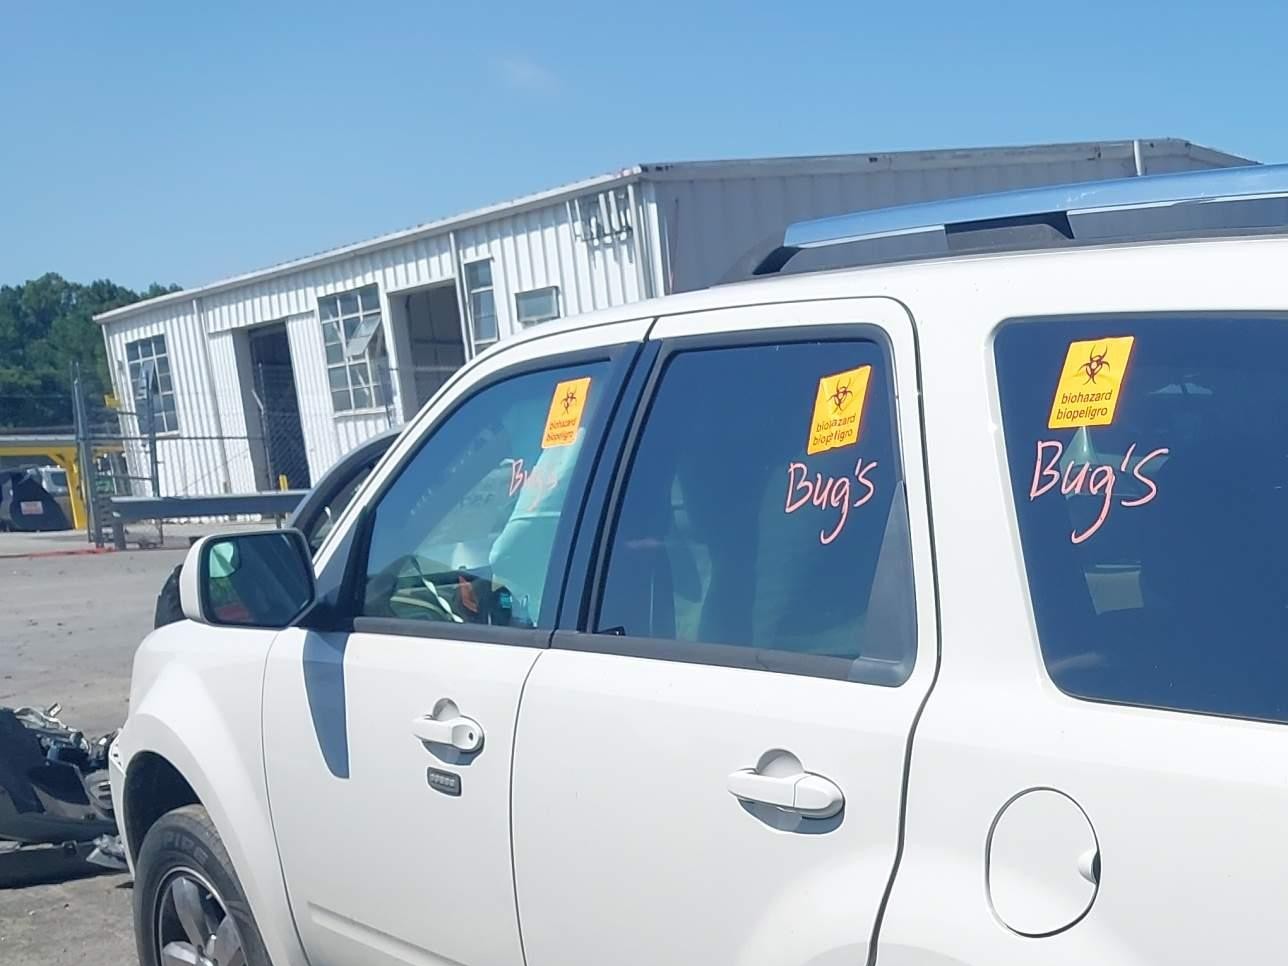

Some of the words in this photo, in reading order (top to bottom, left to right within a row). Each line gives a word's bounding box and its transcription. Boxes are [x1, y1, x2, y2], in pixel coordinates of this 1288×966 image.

[1056, 405, 1108, 421] biopeligro
[1061, 389, 1113, 405] biohazard
[784, 457, 879, 545] Bug's
[1029, 440, 1169, 544] Bug's
